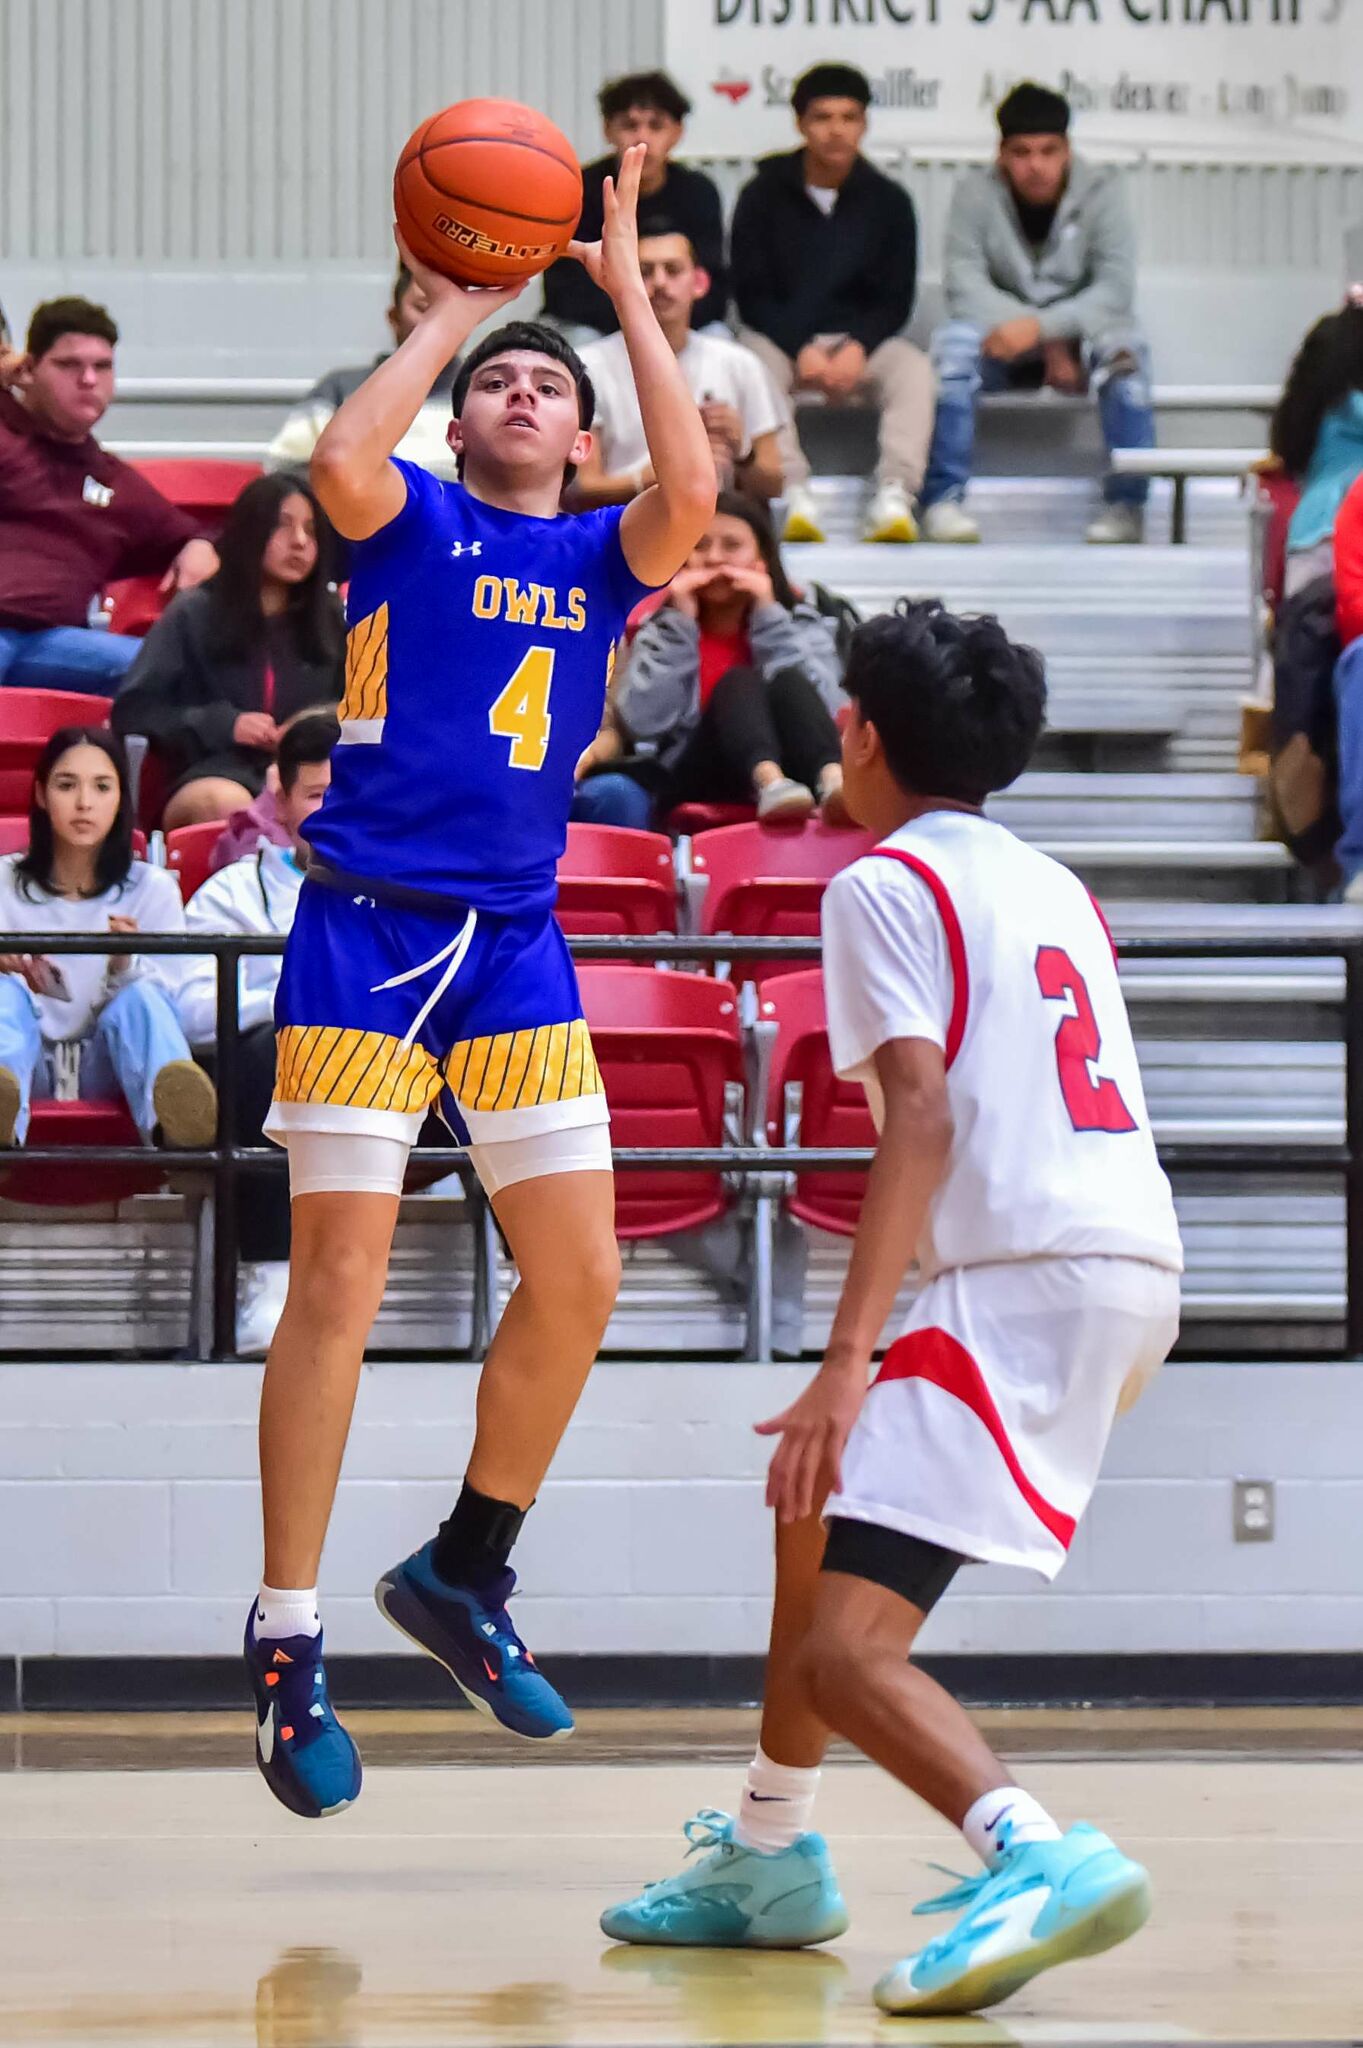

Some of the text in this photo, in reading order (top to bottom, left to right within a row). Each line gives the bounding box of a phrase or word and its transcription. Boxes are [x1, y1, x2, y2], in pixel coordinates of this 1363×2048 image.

[471, 574, 587, 632] OWLS
[488, 645, 556, 771] 4
[1034, 944, 1139, 1133] 2
